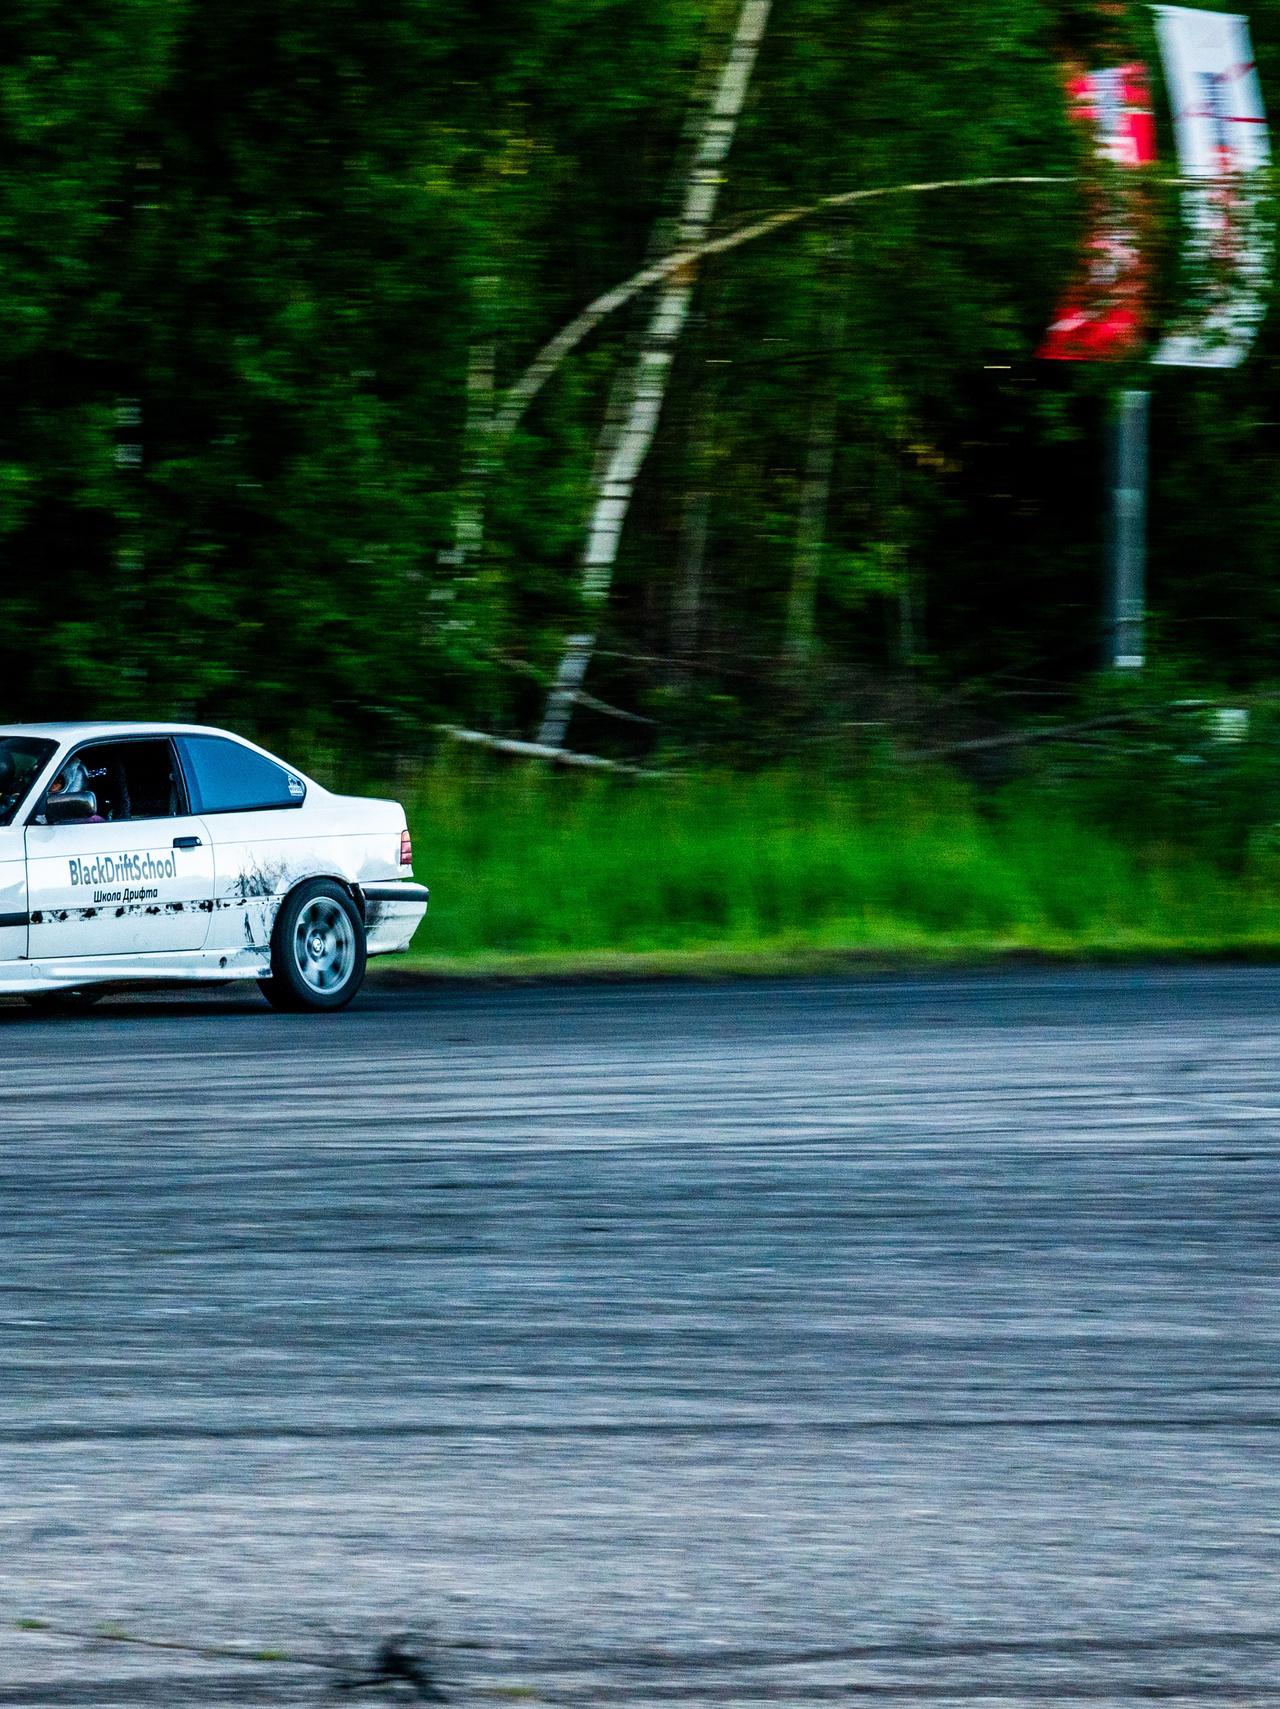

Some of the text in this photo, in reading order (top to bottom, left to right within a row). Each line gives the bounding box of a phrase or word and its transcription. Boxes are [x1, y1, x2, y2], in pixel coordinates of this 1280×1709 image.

[69, 850, 177, 886] BlackDriftSchool
[93, 887, 158, 904] Школа Дрифта
